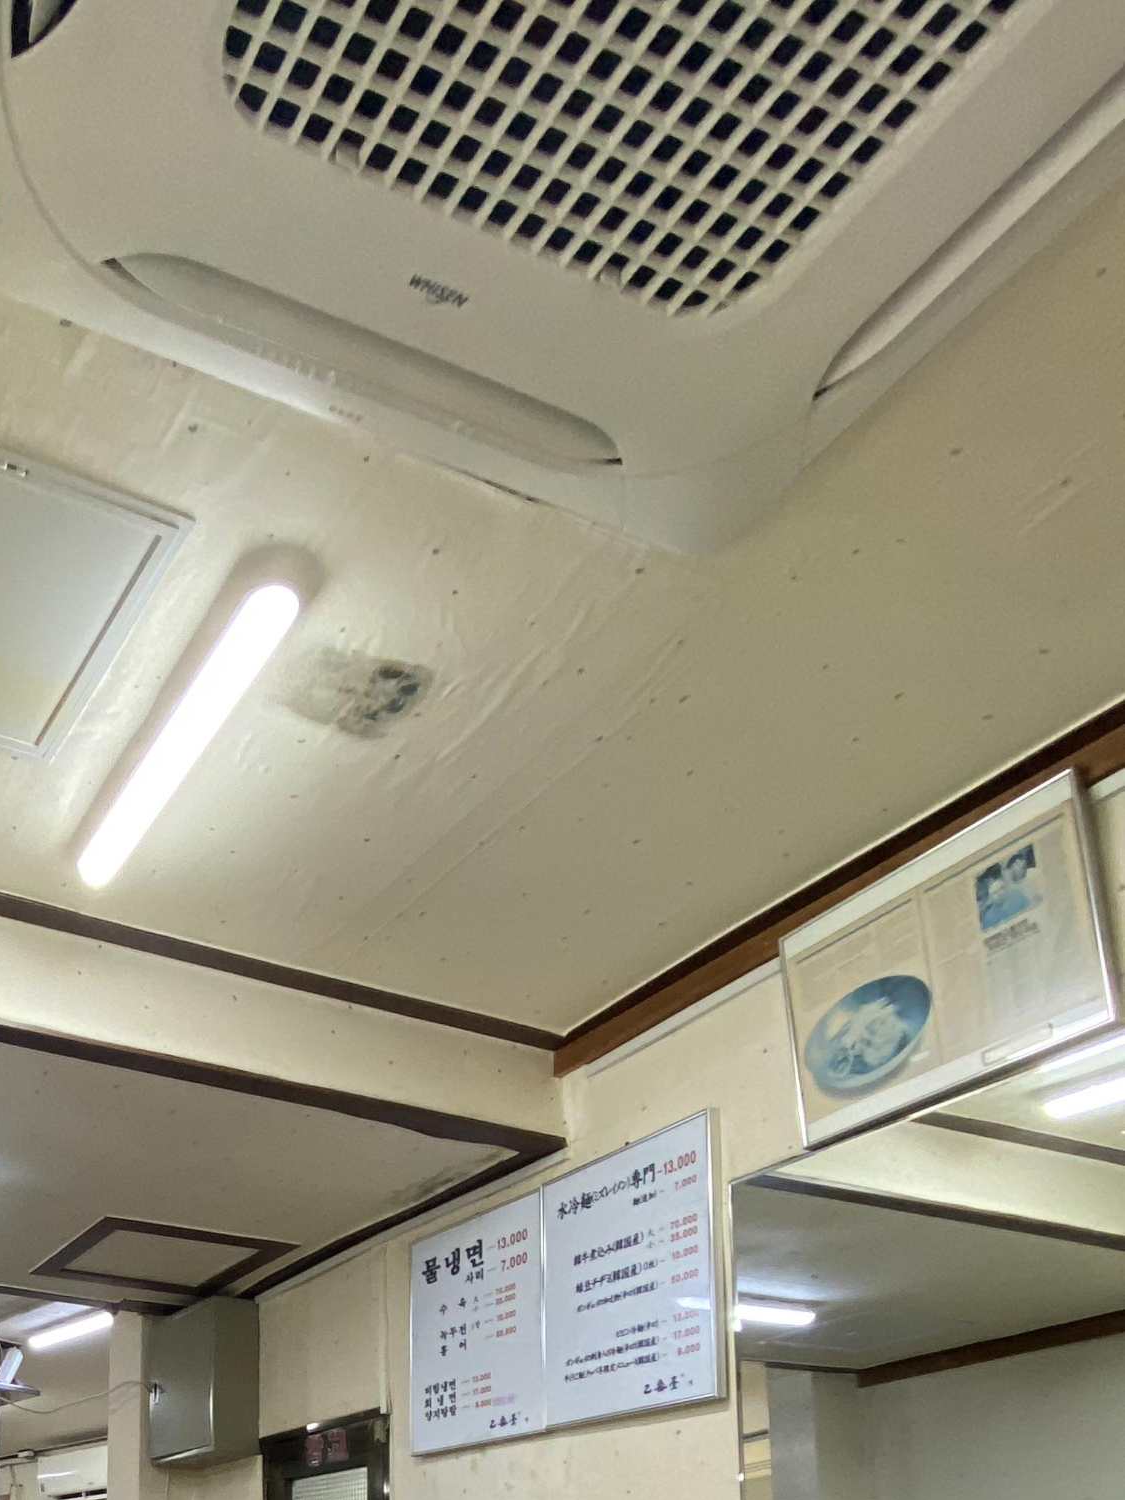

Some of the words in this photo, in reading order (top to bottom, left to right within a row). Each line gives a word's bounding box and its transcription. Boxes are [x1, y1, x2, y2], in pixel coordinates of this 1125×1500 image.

[410, 275, 469, 307] WHISEN
[422, 1239, 484, 1284] 물냉면
[497, 1229, 528, 1250] 13.000
[465, 1268, 484, 1284] 사리
[501, 1252, 528, 1271] 7.000
